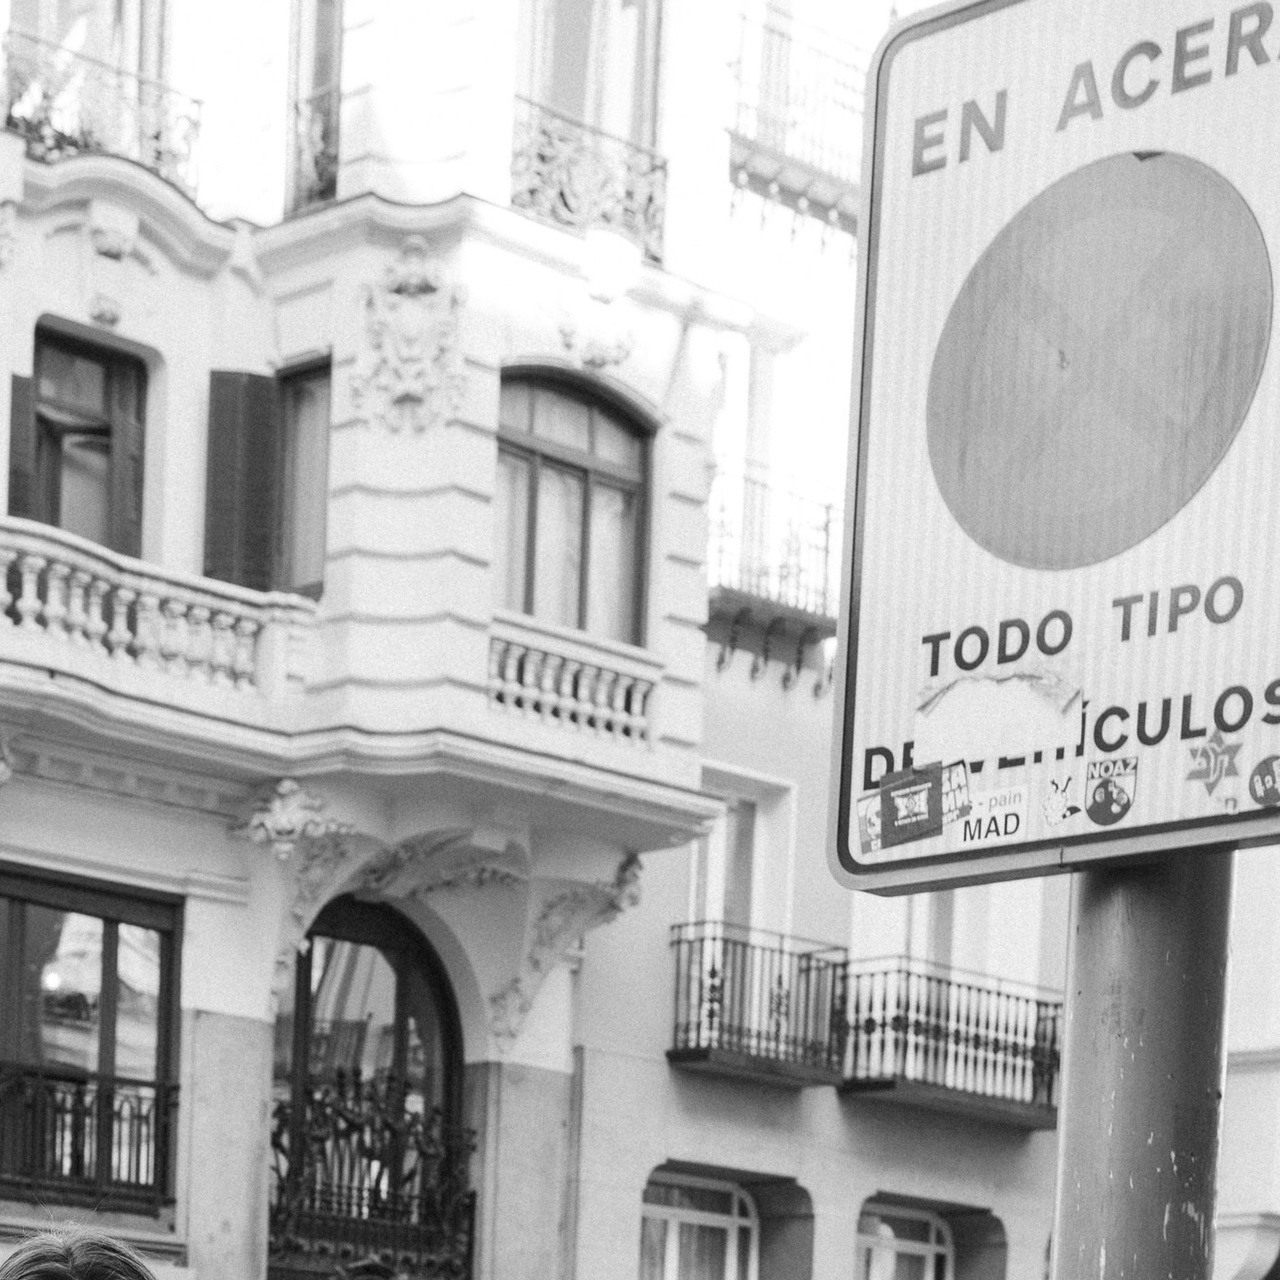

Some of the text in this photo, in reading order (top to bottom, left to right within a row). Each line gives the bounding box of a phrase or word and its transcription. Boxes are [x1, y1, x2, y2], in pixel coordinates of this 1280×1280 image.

[912, 2, 1280, 178] EN ACER
[922, 576, 1244, 677] TODO TIPO
[963, 813, 1020, 842] MAD
